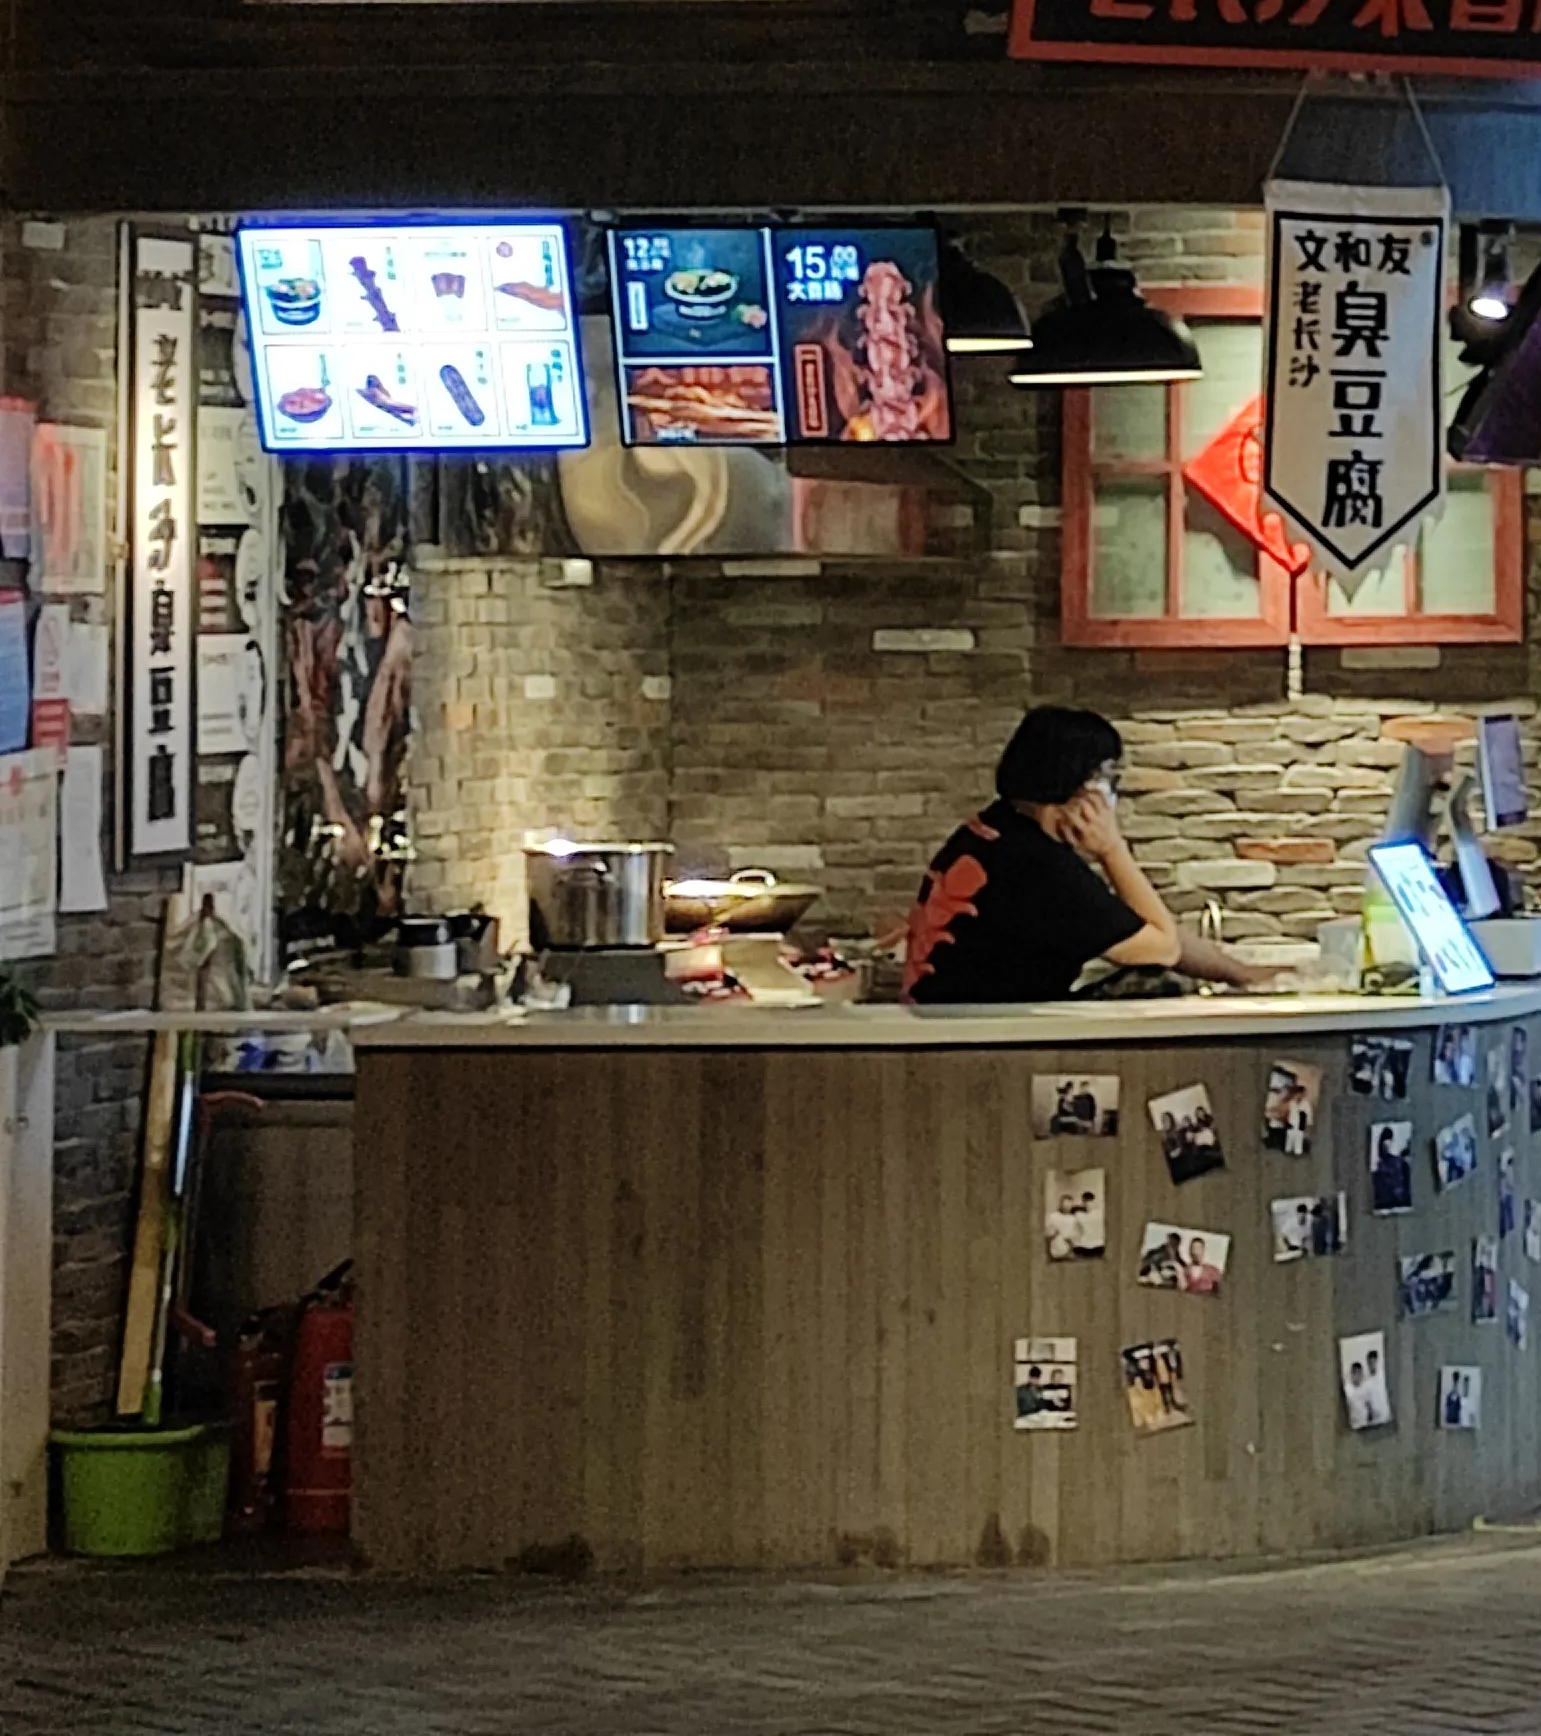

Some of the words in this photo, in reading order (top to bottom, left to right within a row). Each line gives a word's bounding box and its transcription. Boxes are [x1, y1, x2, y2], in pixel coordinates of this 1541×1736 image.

[1294, 229, 1413, 275] 文和友
[1322, 280, 1390, 530] 臭豆腐
